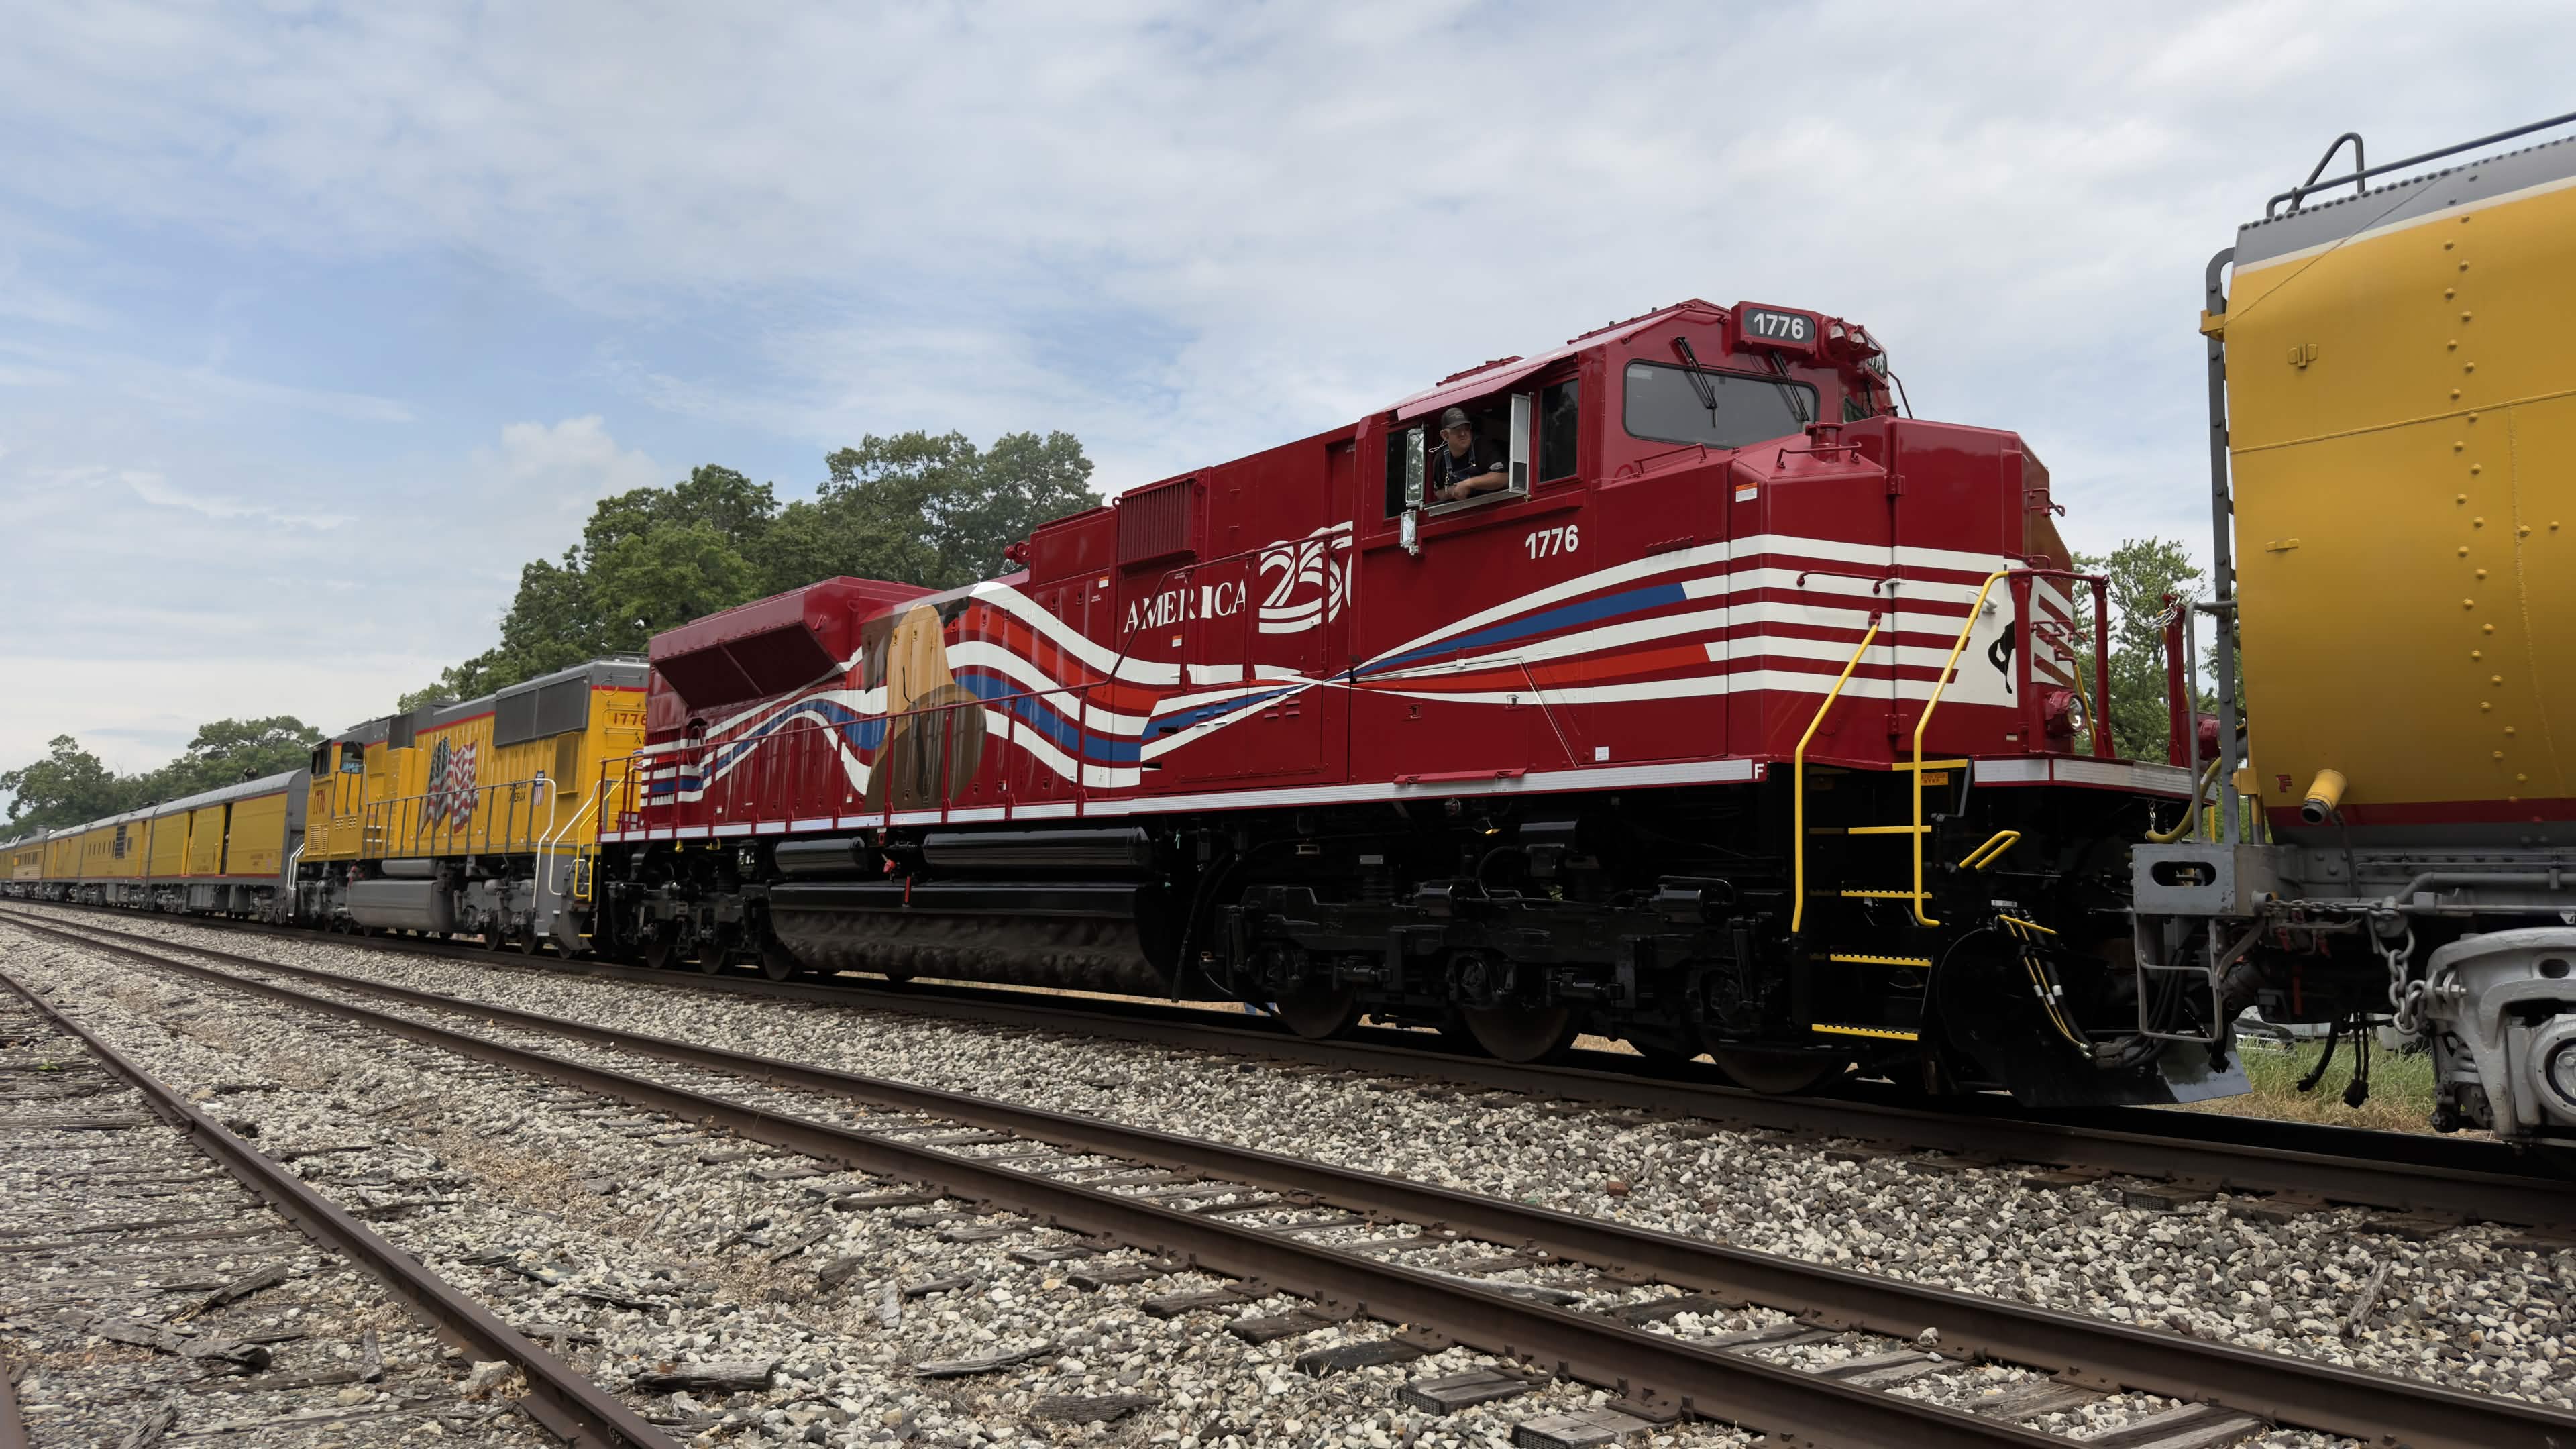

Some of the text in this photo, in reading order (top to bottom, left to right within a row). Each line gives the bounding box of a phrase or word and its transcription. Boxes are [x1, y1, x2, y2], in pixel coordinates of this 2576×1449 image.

[1754, 313, 1804, 339] 1776
[1525, 525, 1578, 559] 1776
[1123, 579, 1246, 633] AMERICA
[1754, 763, 1764, 779] F
[2275, 774, 2292, 792] F
